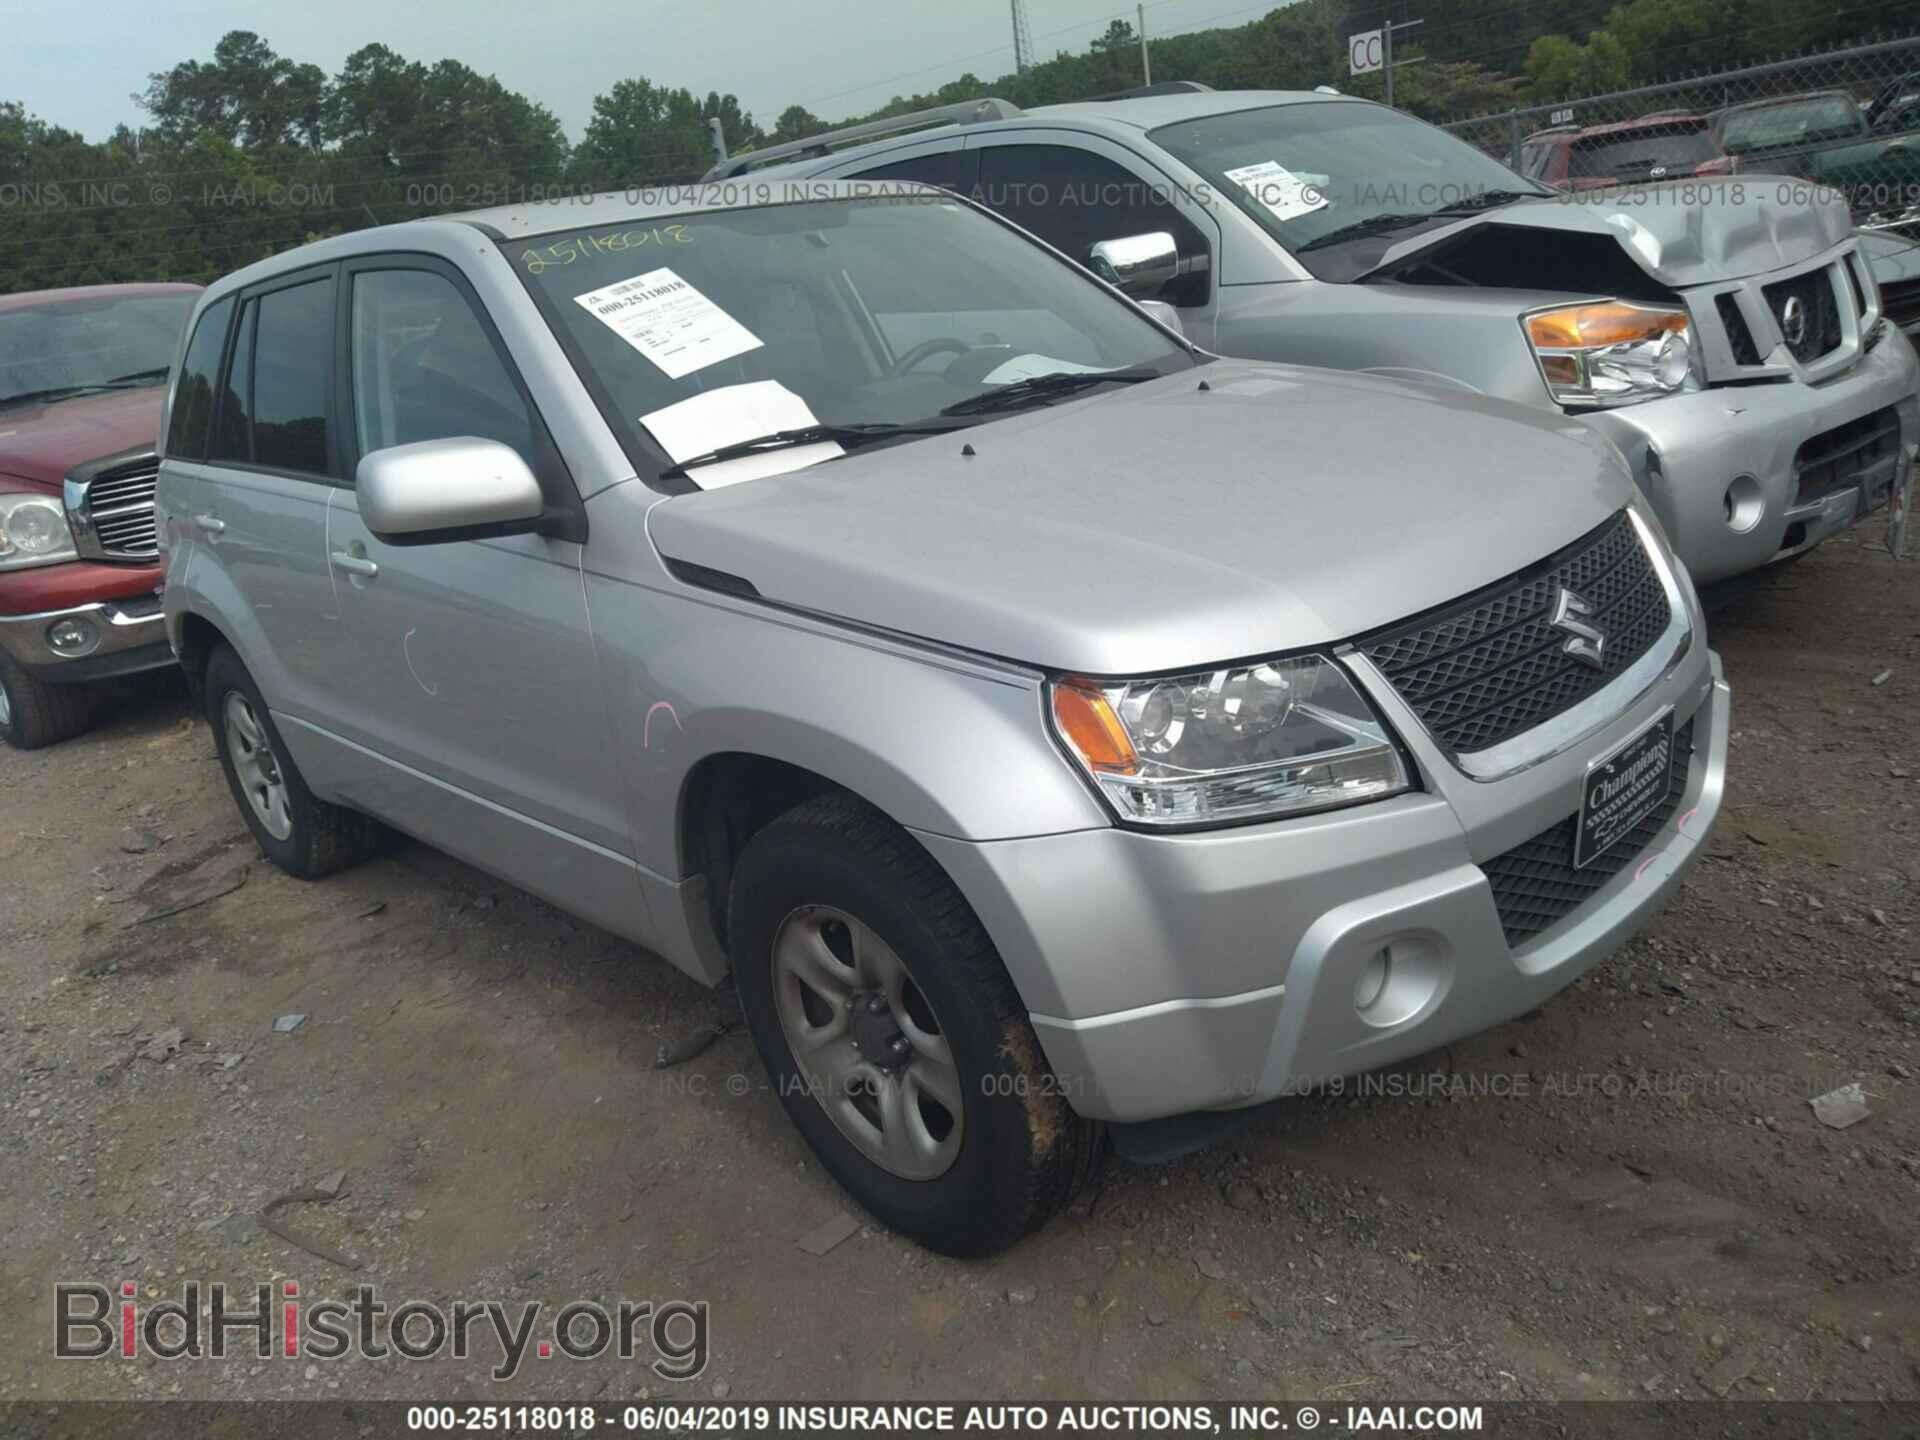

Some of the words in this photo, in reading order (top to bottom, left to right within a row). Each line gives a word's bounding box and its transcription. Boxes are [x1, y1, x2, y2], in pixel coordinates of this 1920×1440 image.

[1352, 36, 1381, 70] CC
[521, 224, 694, 274] 25118018
[598, 281, 687, 315] 000-25118018
